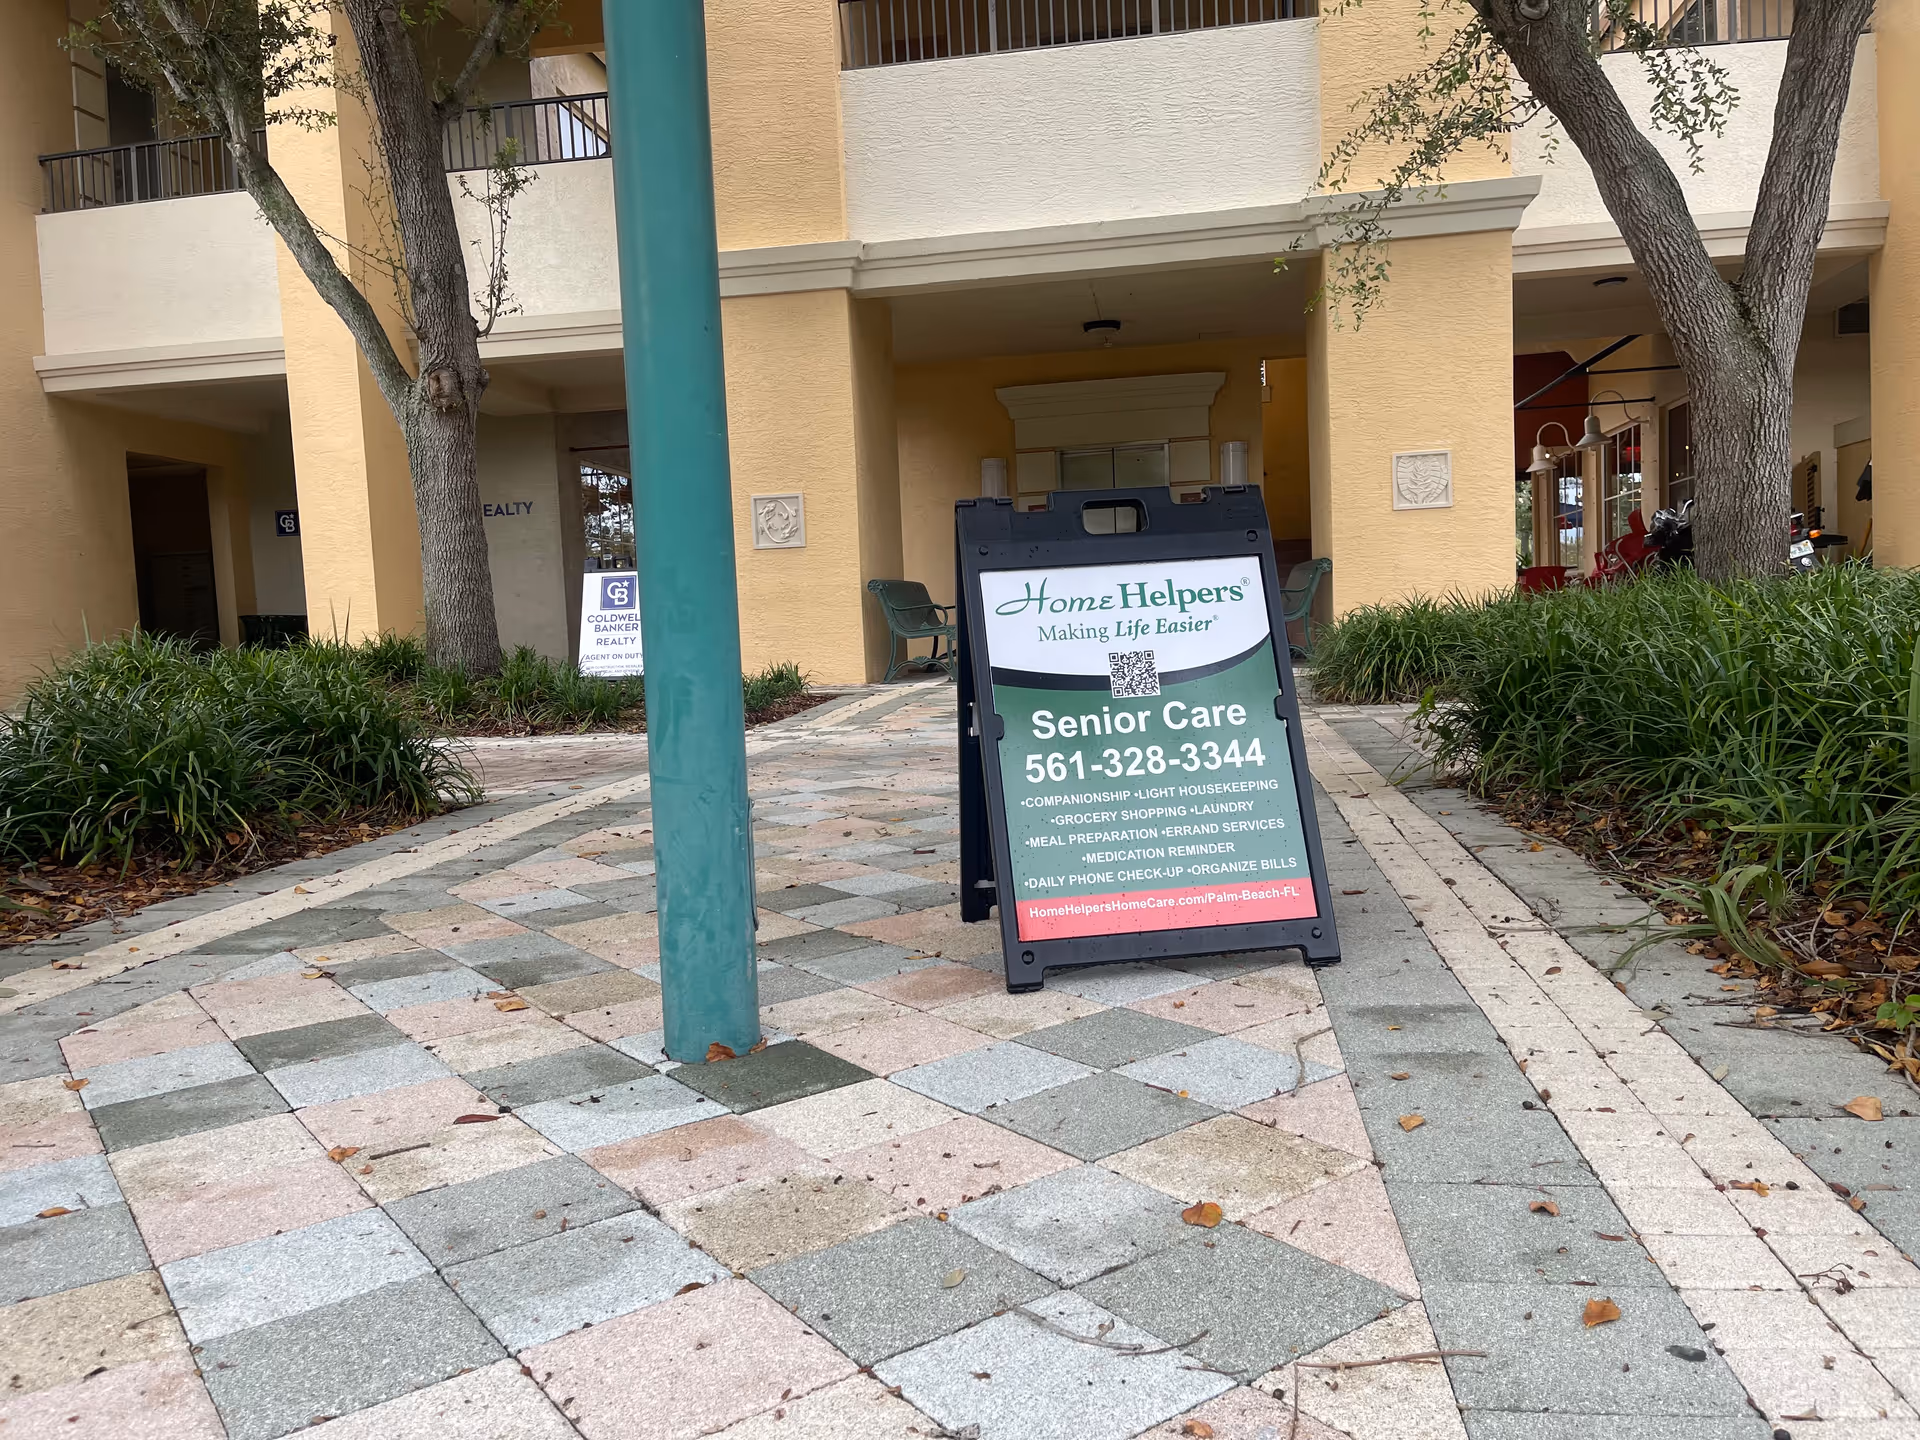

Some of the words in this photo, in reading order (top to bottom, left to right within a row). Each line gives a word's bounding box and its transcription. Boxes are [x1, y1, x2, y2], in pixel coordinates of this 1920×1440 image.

[996, 577, 1115, 616] Home
[595, 623, 638, 632] BANKER
[1038, 623, 1109, 643] Making
[1115, 620, 1150, 640] Life
[597, 637, 636, 645] REALTY
[1032, 707, 1151, 740] Senior
[1163, 701, 1247, 730] Care
[1026, 738, 1266, 784] 561-328-3344
[1179, 779, 1278, 797] HOUSEKEEPING
[1121, 806, 1187, 821] SHOPPING
[1069, 827, 1158, 845] PREPARATION
[1222, 818, 1285, 834] SERVICES
[1168, 842, 1235, 857] REMINDER
[1068, 871, 1114, 885] PHONE
[1118, 866, 1184, 882] CHECK-UP
[1261, 857, 1297, 869] BILLS
[1029, 886, 1300, 918] HomeHelpersHomeCare.com/Palm-Beach-FL
